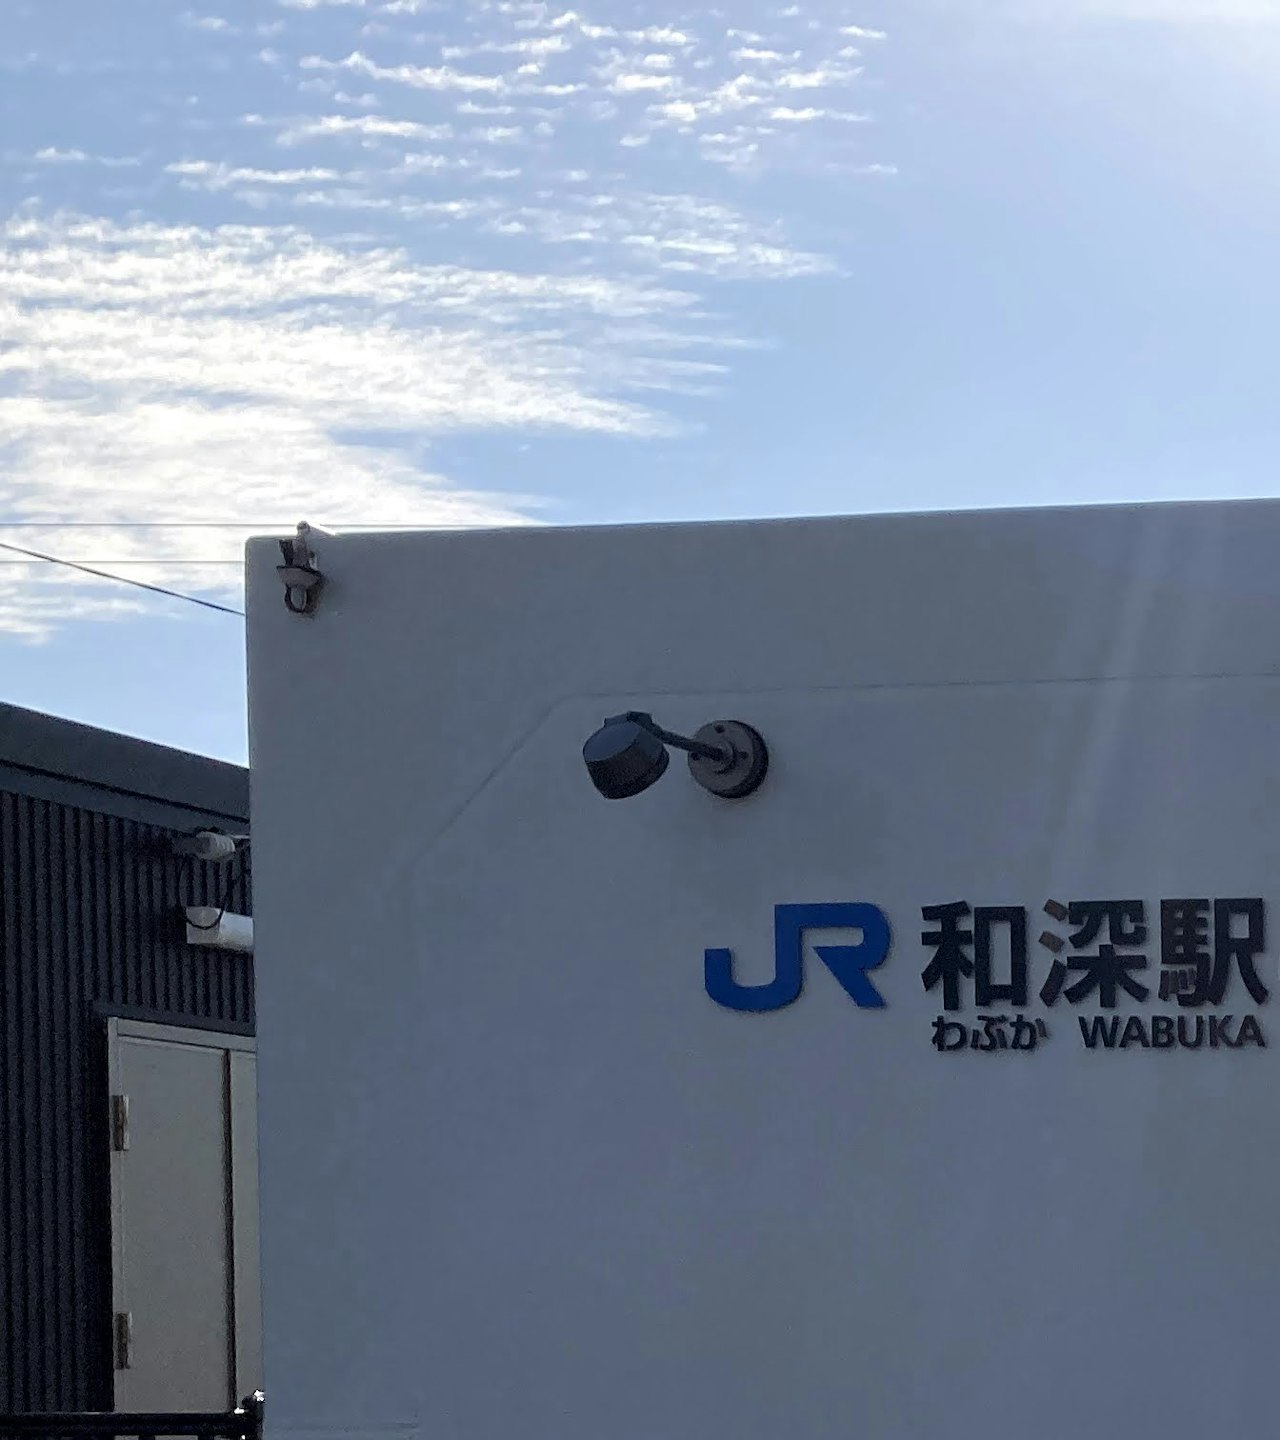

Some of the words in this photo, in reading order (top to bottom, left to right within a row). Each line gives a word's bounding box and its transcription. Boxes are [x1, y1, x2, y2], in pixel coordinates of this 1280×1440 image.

[704, 902, 889, 1012] JR
[921, 898, 1271, 1011] 和深駅
[931, 1014, 1046, 1053] わぶか
[1079, 1014, 1268, 1050] WABUKA
